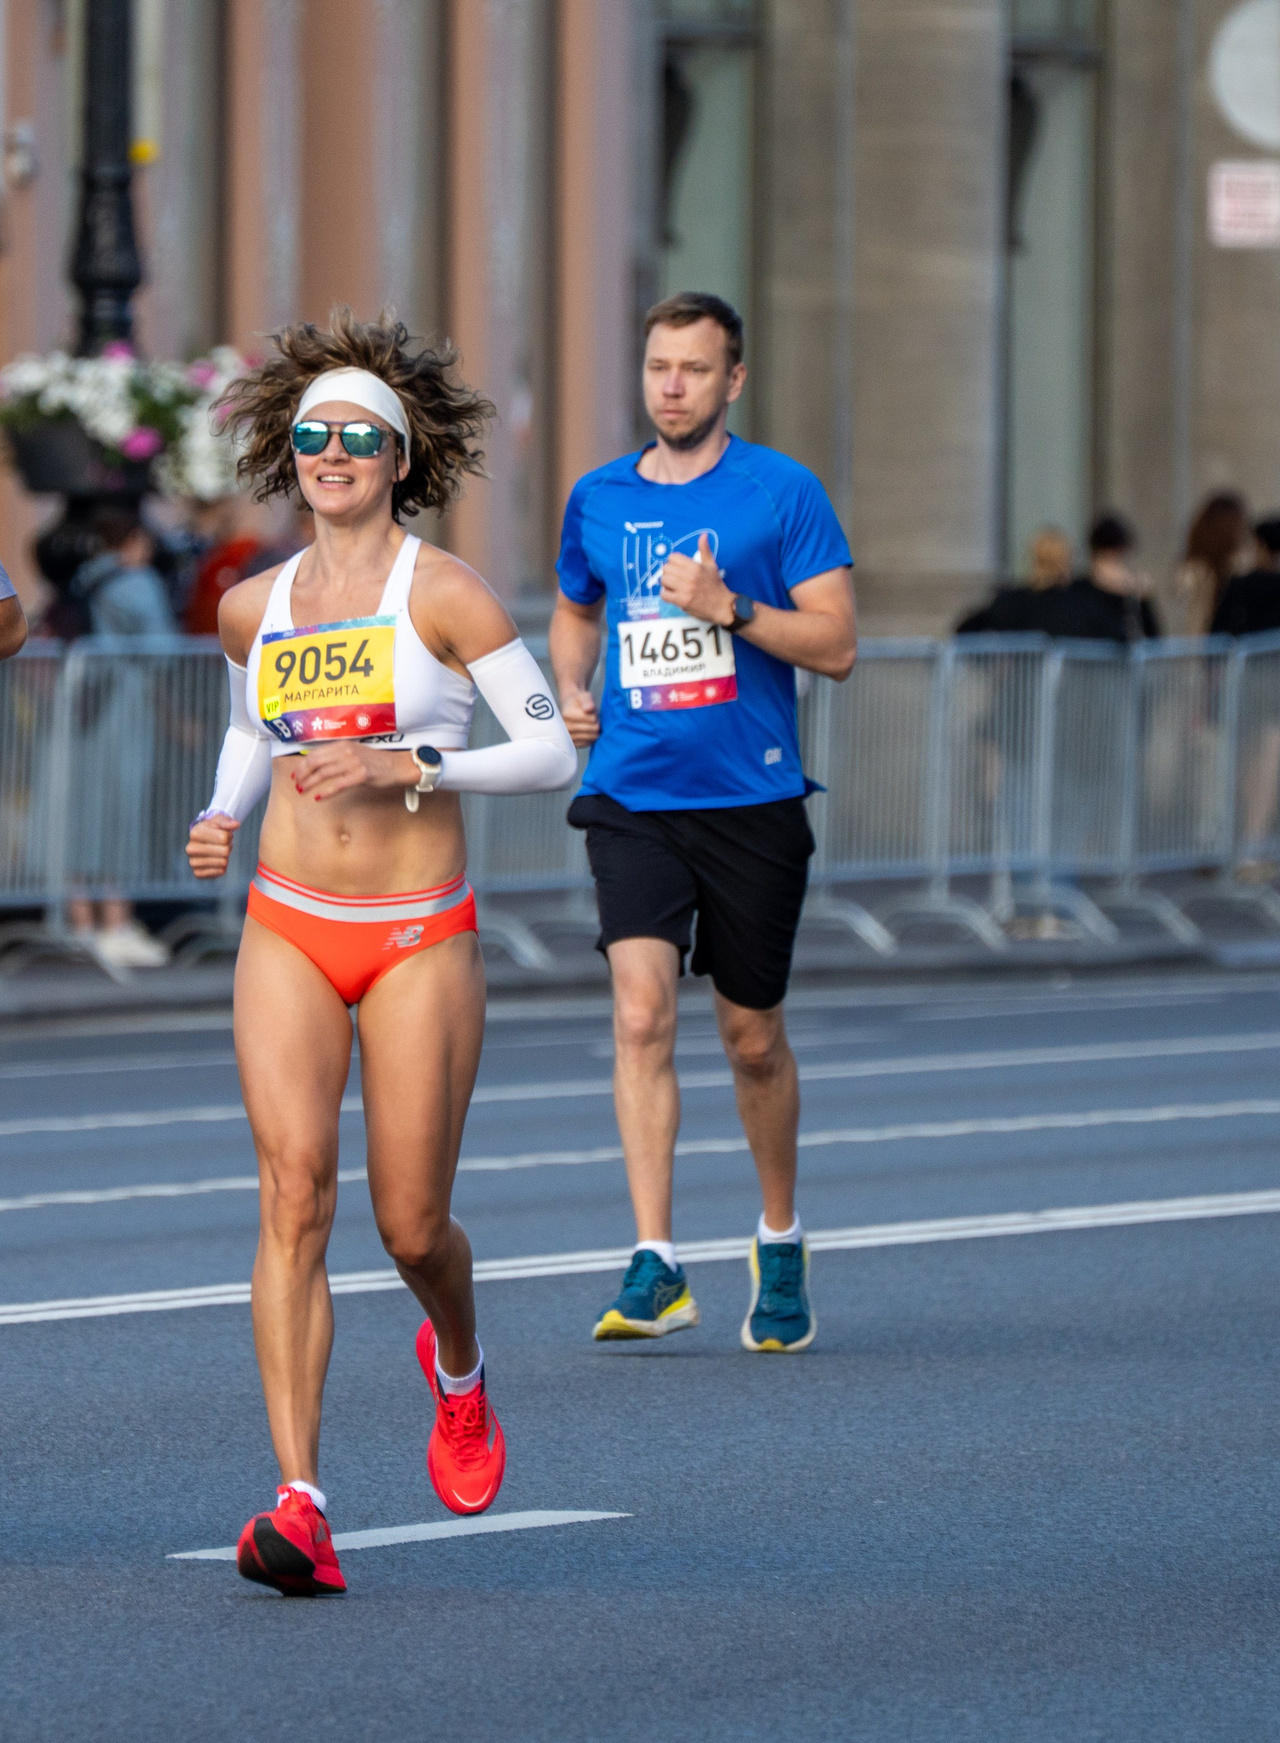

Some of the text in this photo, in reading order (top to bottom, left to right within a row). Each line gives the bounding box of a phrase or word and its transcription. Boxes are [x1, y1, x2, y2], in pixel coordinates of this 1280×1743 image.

[624, 626, 723, 666] 14651
[275, 640, 374, 689] 9054
[643, 663, 706, 678] ВЛАДИМИР
[284, 684, 360, 703] МАРГАРИТА
[266, 700, 280, 714] VIP
